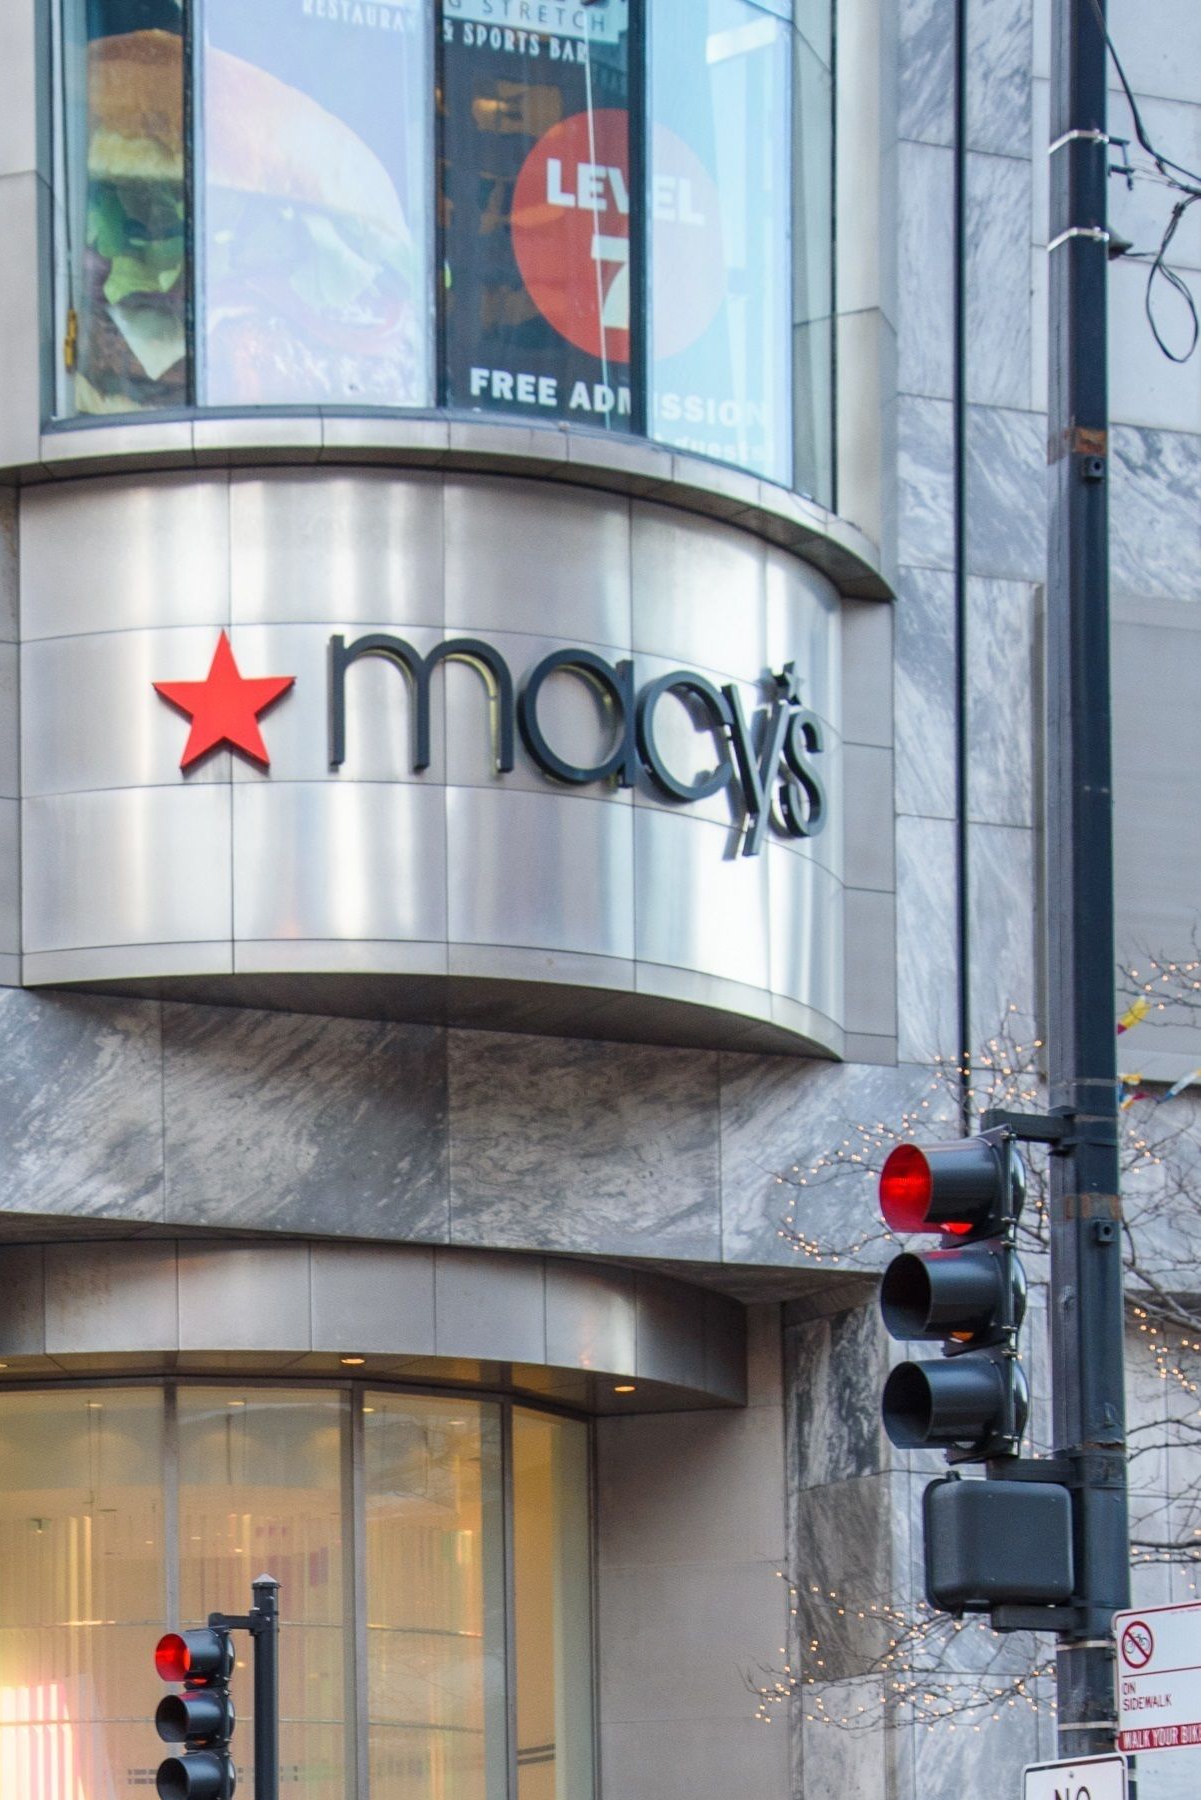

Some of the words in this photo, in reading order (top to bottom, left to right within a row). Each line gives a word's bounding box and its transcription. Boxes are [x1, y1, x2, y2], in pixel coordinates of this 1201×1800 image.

[463, 22, 539, 57] SPORTS
[470, 367, 558, 407] FREE
[1123, 1694, 1173, 1712] SIDEWALK
[1123, 1730, 1150, 1749] WALK
[1152, 1727, 1178, 1746] YOUR
[1181, 1725, 1201, 1744] BIK
